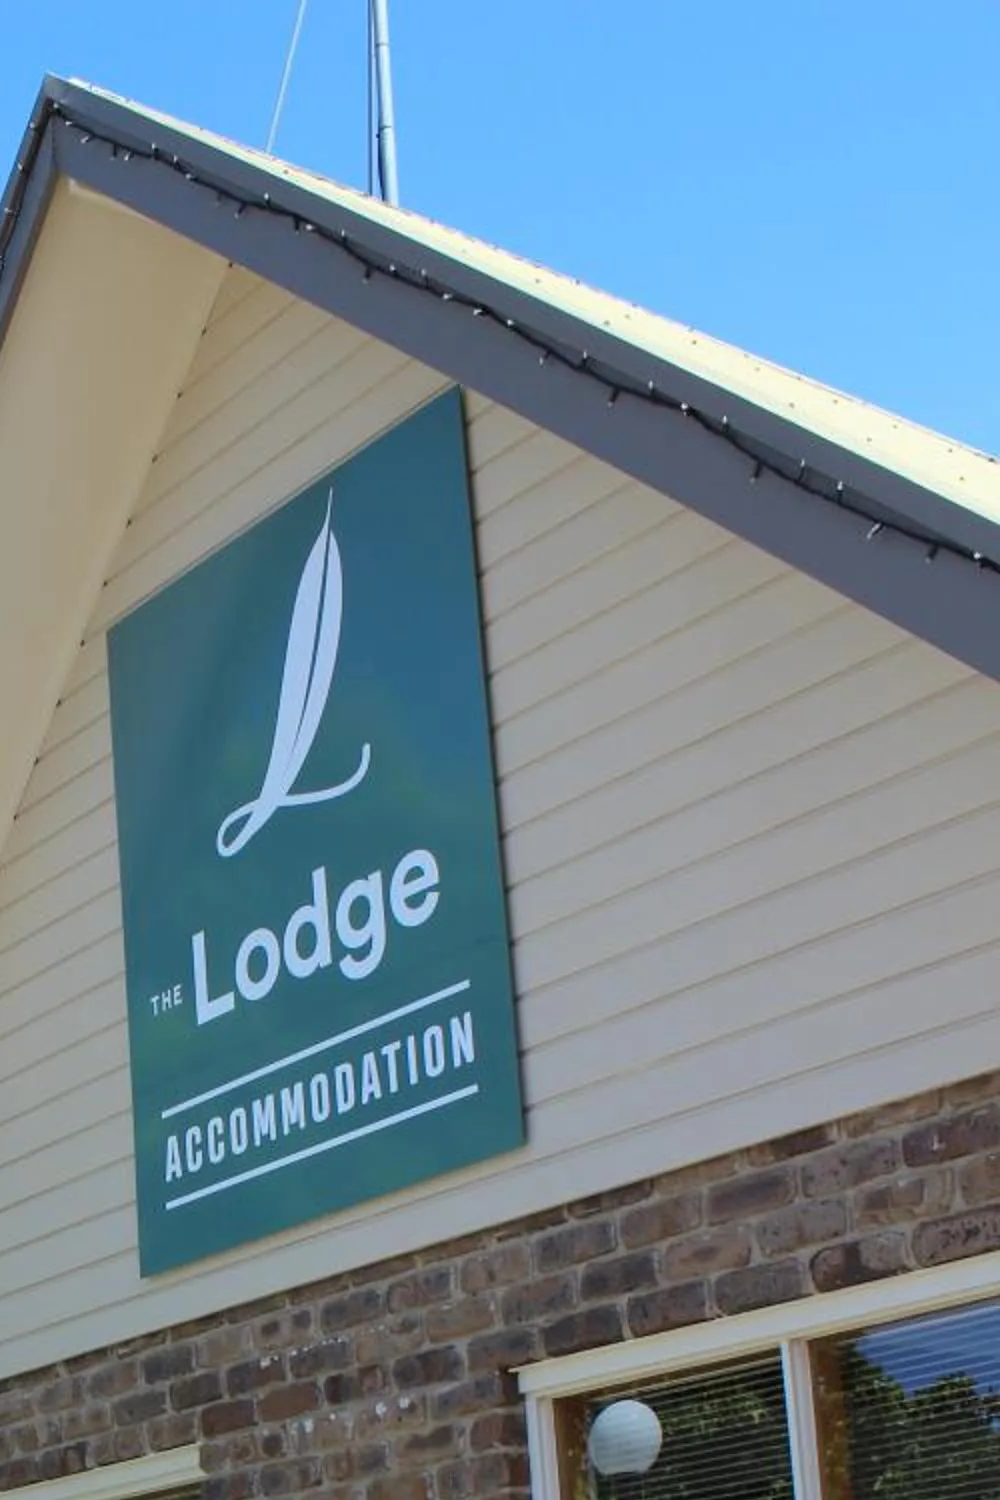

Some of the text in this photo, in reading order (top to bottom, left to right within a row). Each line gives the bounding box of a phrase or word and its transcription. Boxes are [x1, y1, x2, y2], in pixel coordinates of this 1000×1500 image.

[150, 849, 440, 1025] THE Lodge
[165, 1011, 476, 1182] ACCOMMODATION
